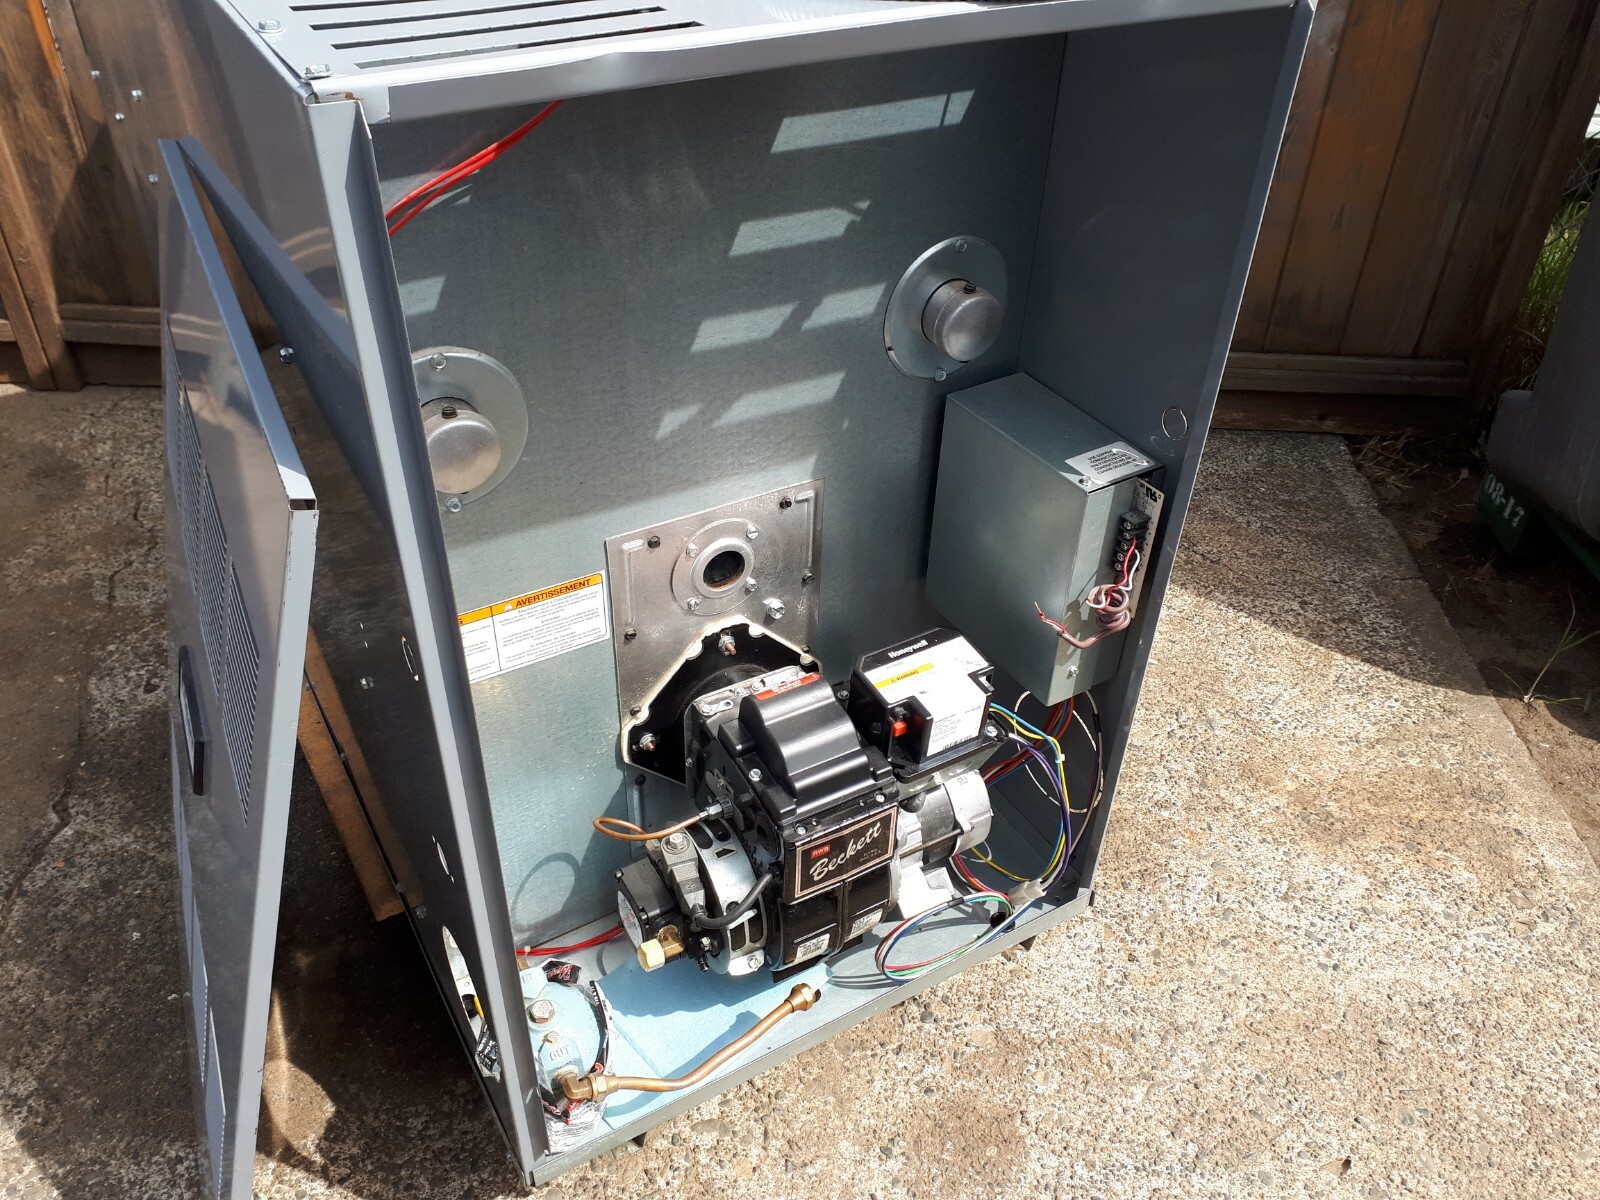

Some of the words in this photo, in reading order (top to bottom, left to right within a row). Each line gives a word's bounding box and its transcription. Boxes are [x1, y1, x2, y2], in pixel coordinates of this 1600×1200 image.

[516, 578, 591, 607] AVERTISSEMENT
[888, 640, 928, 658] Honeywell
[896, 670, 919, 681] WARNING
[809, 821, 882, 882] Beckett
